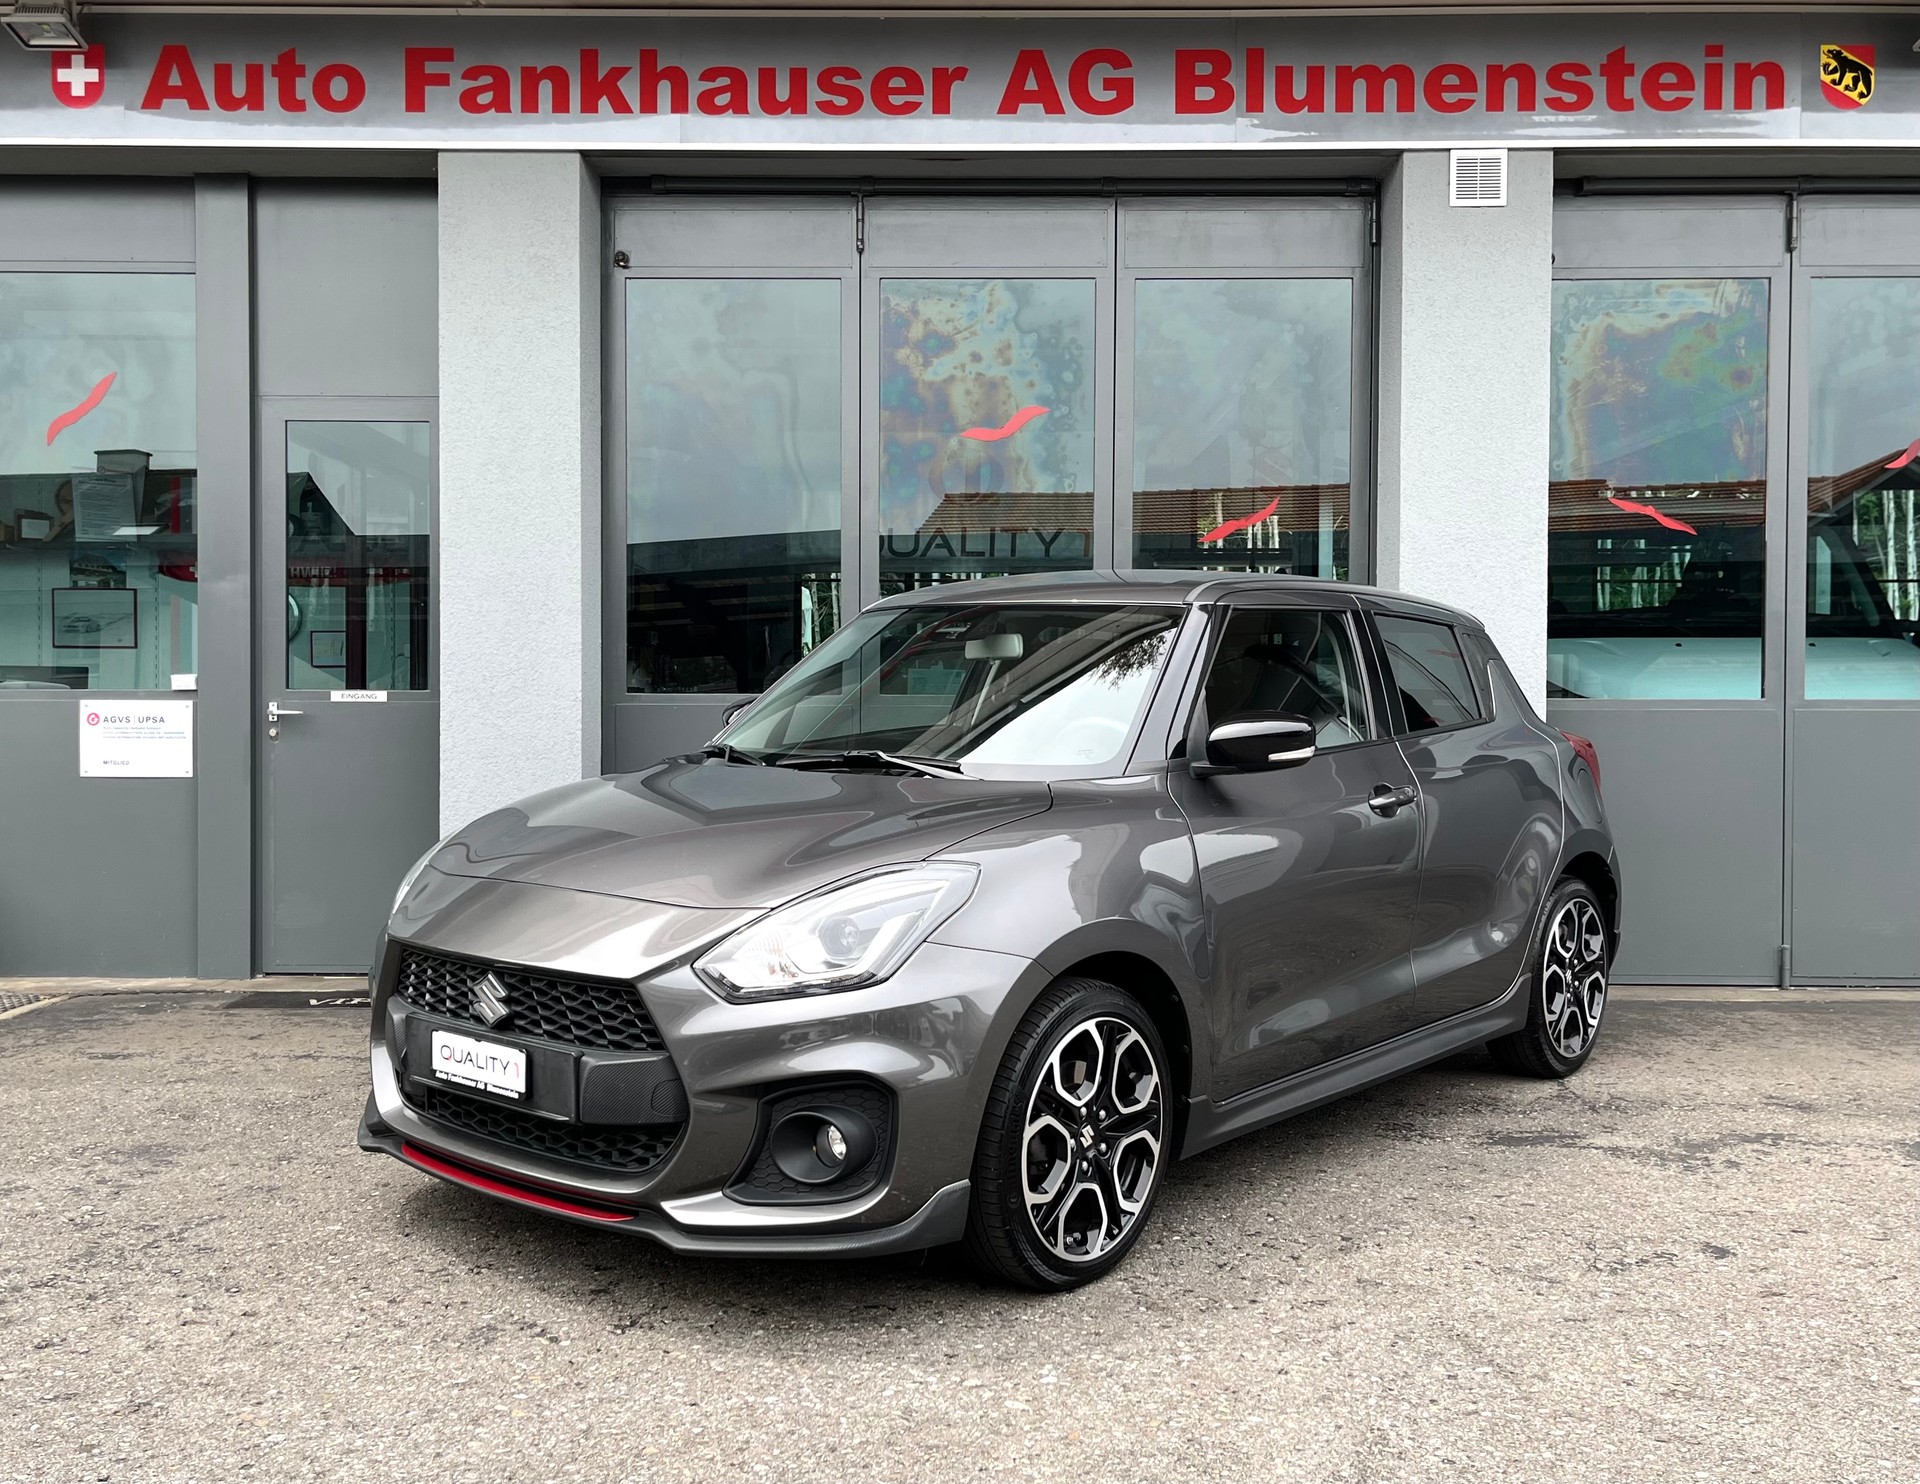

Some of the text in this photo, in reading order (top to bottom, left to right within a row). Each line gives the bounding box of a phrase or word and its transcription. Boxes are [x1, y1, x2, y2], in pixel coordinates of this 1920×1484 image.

[142, 45, 1784, 115] Auto Fankhauser AG Blumenstein
[879, 527, 1065, 558] UALITY
[440, 1044, 519, 1079] QUALITY 1
